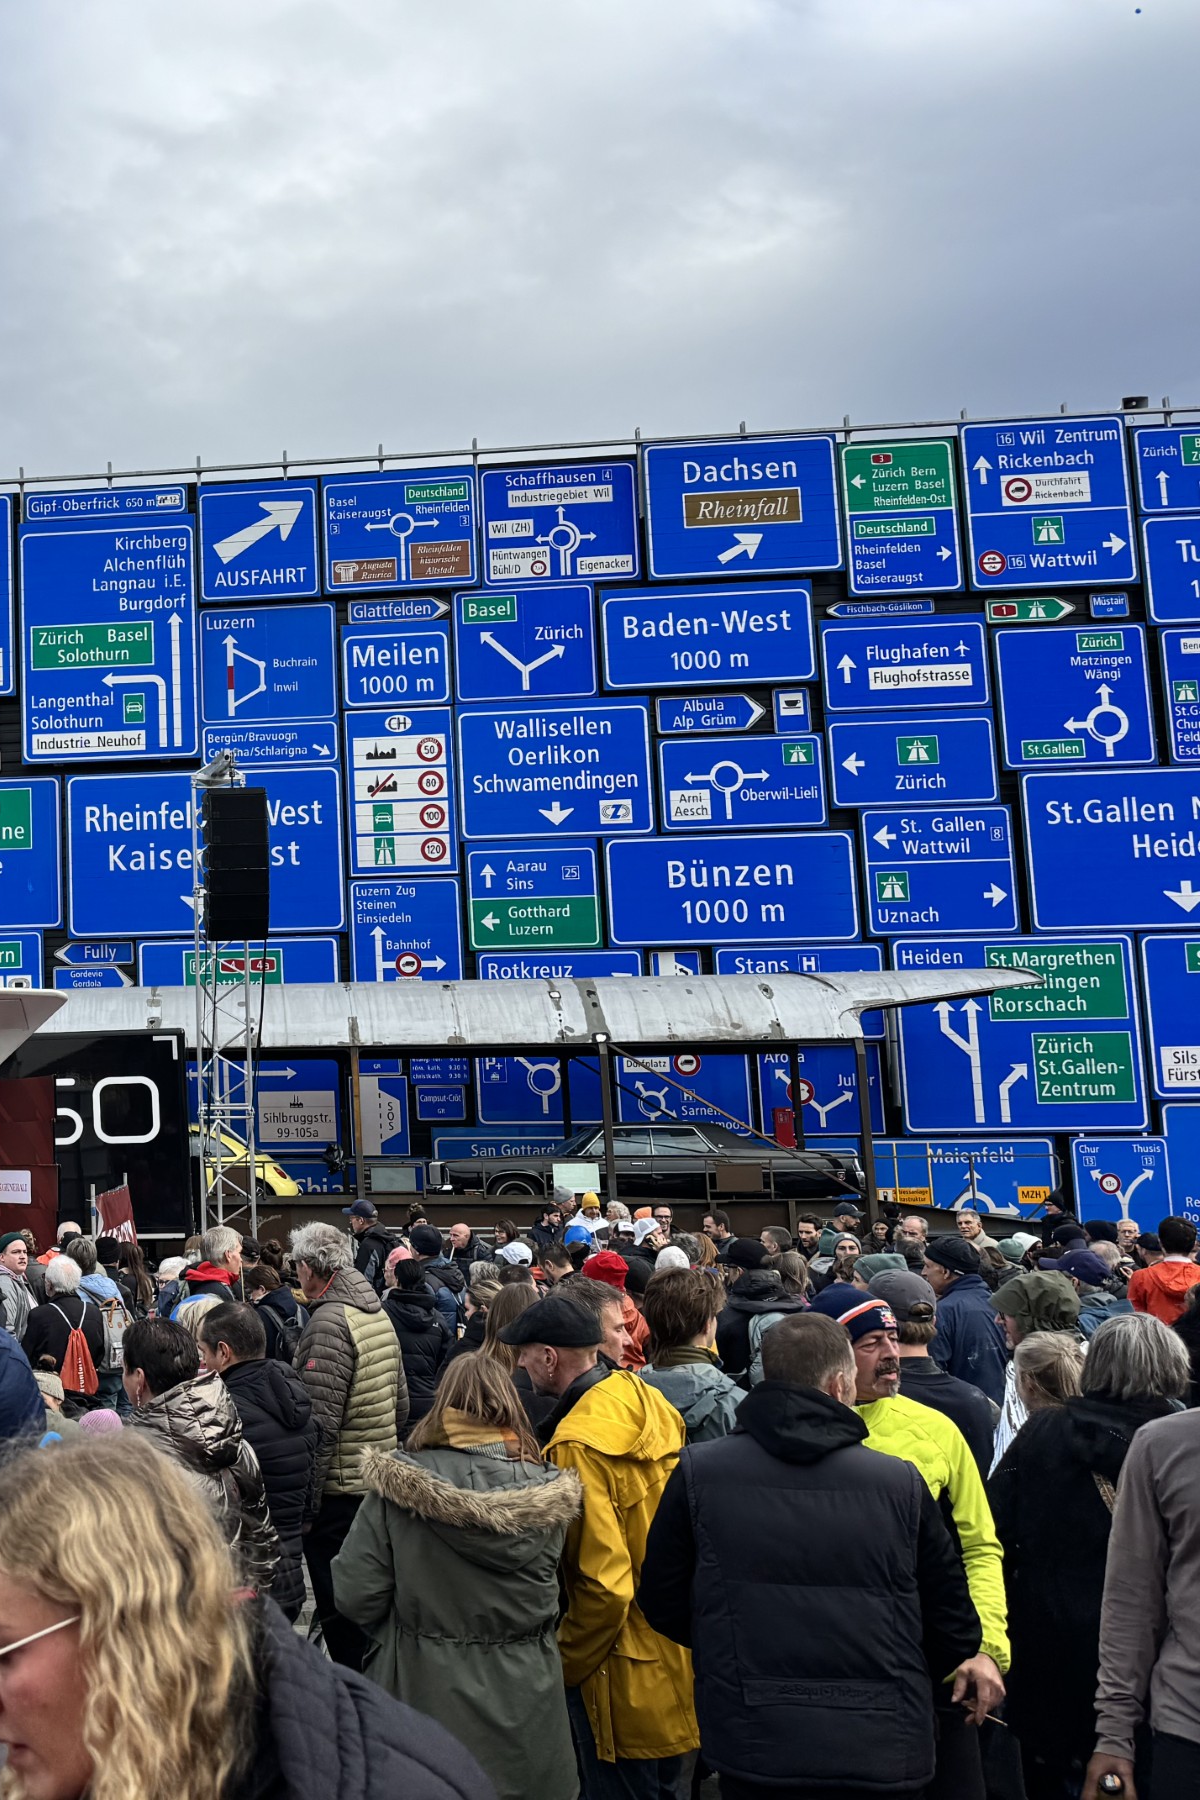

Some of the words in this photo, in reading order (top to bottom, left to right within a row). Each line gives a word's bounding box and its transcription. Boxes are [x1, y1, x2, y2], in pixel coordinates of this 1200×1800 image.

[1020, 430, 1045, 445] Wil
[1055, 429, 1117, 443] Zentrum
[998, 450, 1093, 469] Rickenbach
[684, 458, 796, 483] Dachsen
[872, 467, 905, 478] Zürich
[911, 467, 936, 476] Bern
[506, 472, 595, 486] Schaffhausen
[873, 482, 908, 491] Luzern
[915, 478, 944, 489] Basel
[409, 485, 464, 498] Deutschland
[512, 490, 588, 502] Industriegebiet
[594, 488, 609, 497] Wil
[874, 494, 946, 506] Rheinfelden-Ost
[330, 508, 391, 520] Kaiseraugst
[416, 502, 469, 514] Rheinfelden
[697, 497, 788, 520] Rheinfall
[859, 521, 927, 534] Deutschland
[116, 535, 186, 550] Kirchberg
[855, 543, 920, 555] Rheinfelden
[104, 554, 185, 572] Alchenflüh
[580, 558, 629, 572] Eigenacker
[1029, 550, 1097, 567] Wattwil
[215, 567, 306, 587] AUSFAHRT
[120, 593, 186, 613] Burgdorf
[354, 602, 430, 618] Glattfelden
[207, 617, 254, 630] Luzern
[624, 610, 791, 638] Baden-West
[39, 630, 83, 645] Zürich
[108, 627, 147, 642] Basel
[535, 624, 583, 640] Zürich
[58, 647, 129, 663] Solothurn
[353, 642, 438, 667] Meilen
[867, 643, 949, 663] Flughafen
[273, 657, 317, 667] Buchrain
[1071, 656, 1132, 667] Matzingen
[874, 669, 969, 686] Flughofstrasse
[1084, 668, 1120, 681] Wängi
[32, 691, 113, 711] Langenthal
[683, 699, 724, 712] Albula
[388, 717, 406, 730] CH
[494, 716, 611, 739] Wallisellen
[673, 715, 694, 727] Alp
[701, 714, 736, 725] Grüm
[37, 737, 90, 749] Industrie
[94, 734, 141, 747] Neuhof
[424, 745, 435, 755] 50
[509, 745, 599, 765] Oerlikon
[426, 778, 436, 788] 80
[473, 770, 638, 793] Schwamendingen
[680, 794, 702, 803] Arni
[740, 786, 817, 801] Oberwil-Lieli
[426, 811, 439, 821] 100
[675, 805, 708, 816] Aesch
[1046, 797, 1174, 824] St.Gallen
[901, 819, 921, 833] St.
[932, 817, 985, 832] Gallen
[427, 844, 440, 854] 120
[507, 861, 546, 872] Aarau
[668, 860, 793, 888] Bünzen
[507, 878, 533, 890] Sins
[356, 887, 390, 896] Luzern
[396, 886, 415, 897] Zug
[357, 912, 411, 923] Einsiedeln
[508, 904, 570, 918] Gotthard
[878, 907, 939, 923] Uznach
[386, 939, 430, 950] Bahnhof
[85, 945, 116, 961] Fully
[902, 949, 962, 964] Heiden
[990, 950, 1115, 970] St.Margrethen
[488, 961, 573, 978] Rotkreuz
[735, 961, 789, 973] Stans
[994, 995, 1086, 1012] Rorschach
[264, 1112, 331, 1125] Sihlbruggstr.
[277, 1128, 318, 1137] 99-105a
[1079, 1145, 1099, 1153] Chur
[1132, 1144, 1160, 1152] Thusis
